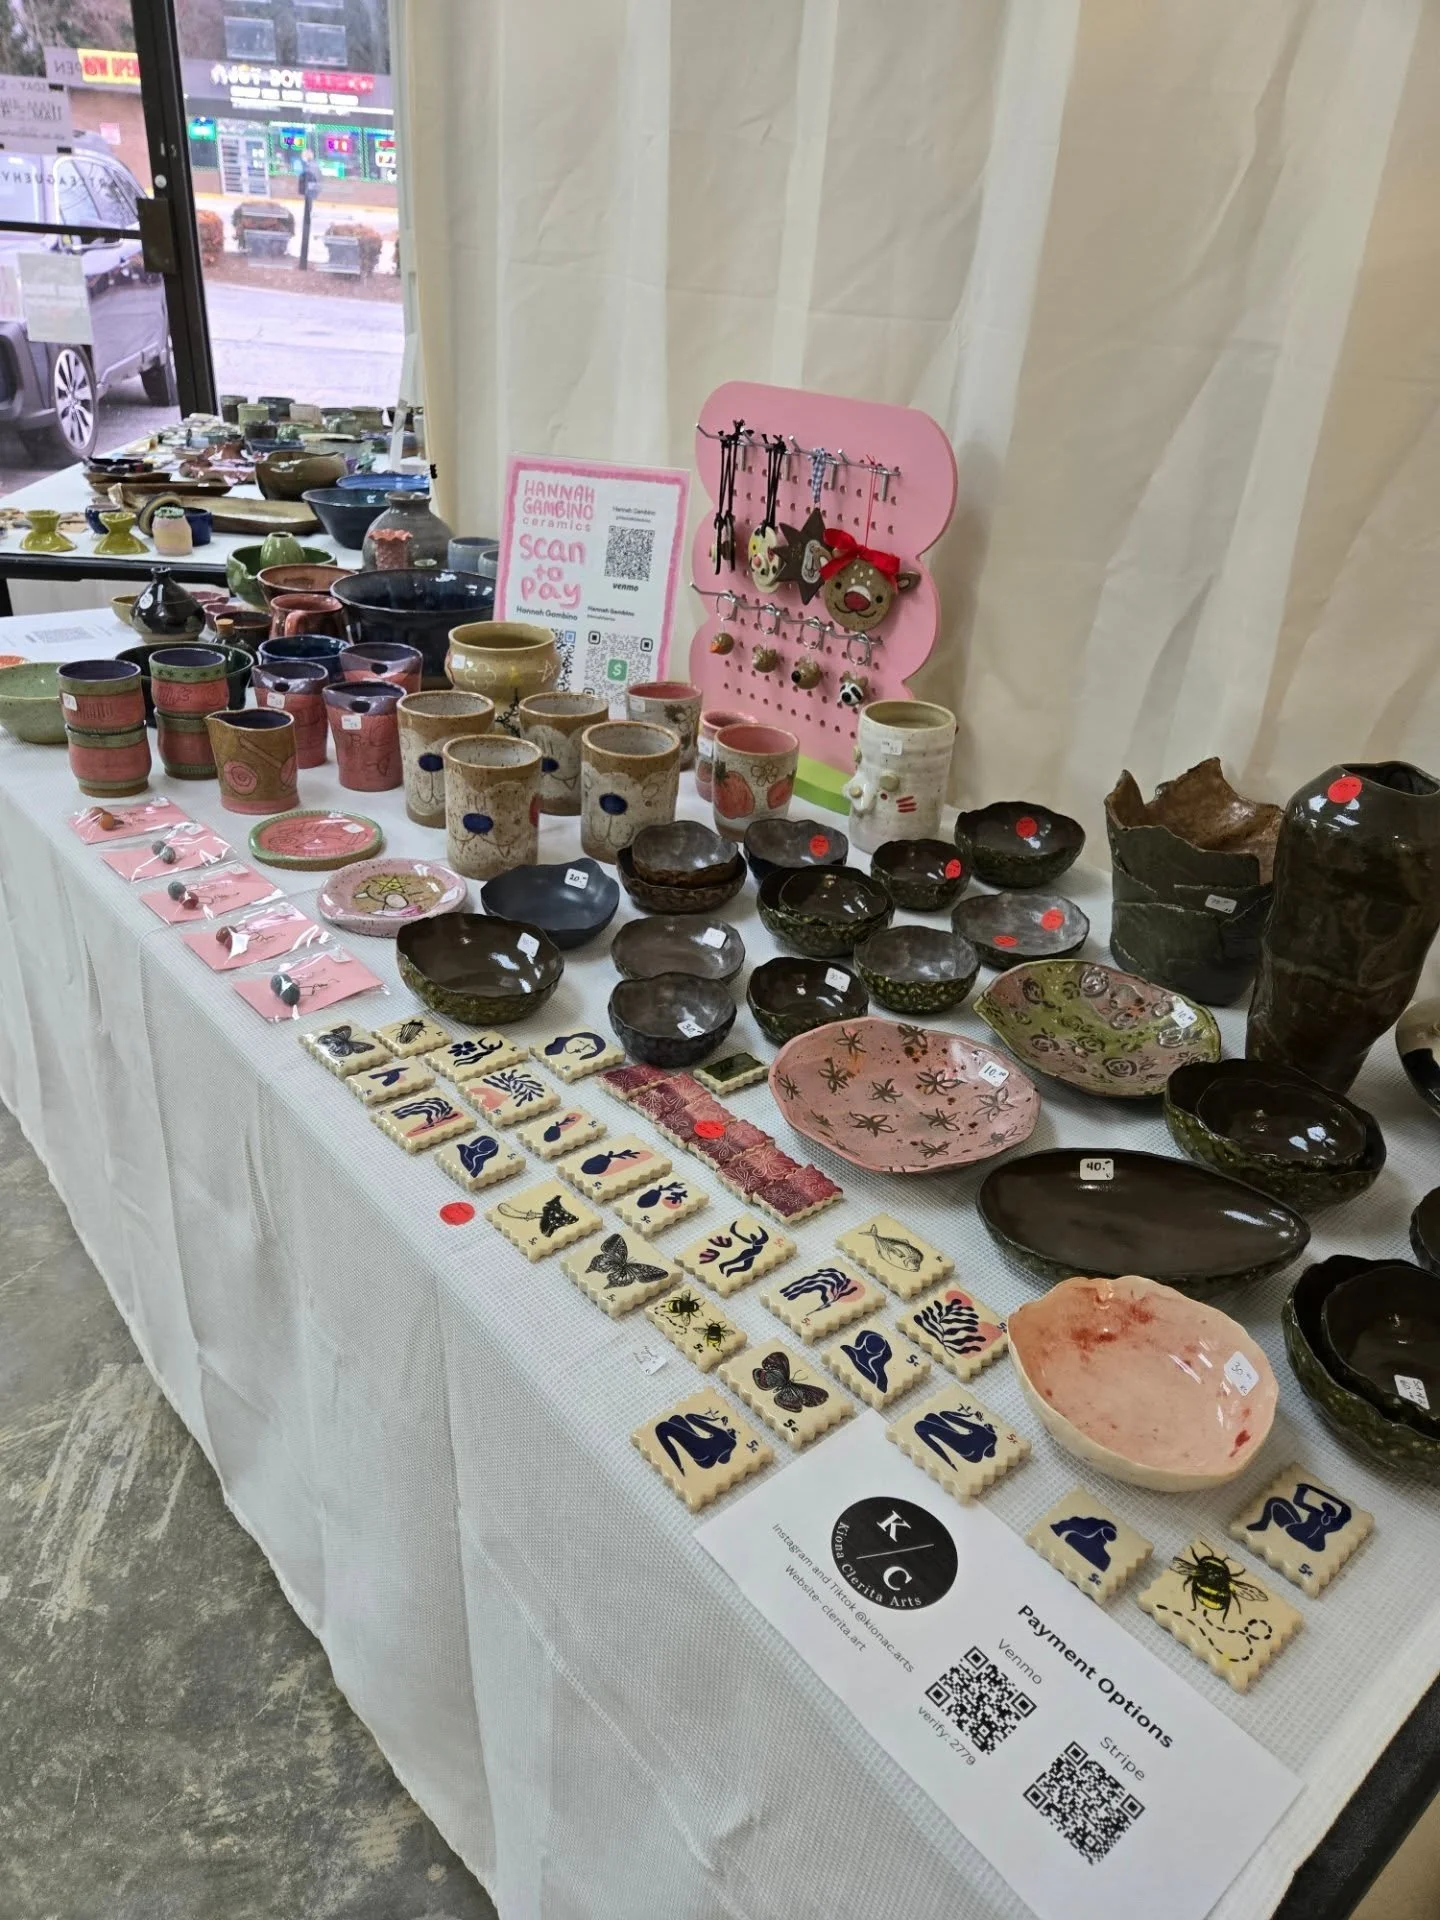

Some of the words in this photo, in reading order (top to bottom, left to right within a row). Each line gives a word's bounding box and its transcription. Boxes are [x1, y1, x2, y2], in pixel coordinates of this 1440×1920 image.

[524, 480, 595, 503] HANNAH
[522, 497, 594, 521] GAMBINO
[522, 516, 592, 532] ceramics
[613, 505, 632, 514] Hannah
[519, 533, 587, 566] scan
[535, 563, 564, 582] to
[612, 581, 639, 592] venmo
[520, 576, 582, 609] pay
[516, 605, 544, 618] Hannah
[545, 608, 578, 621] Gambino
[587, 605, 610, 615] Hannah
[610, 608, 635, 618] Gambino
[834, 1521, 851, 1560] Kiona
[876, 1510, 912, 1542] K
[841, 1562, 884, 1603] Clerita
[883, 1565, 912, 1592] C
[772, 1523, 814, 1569] Instagram
[811, 1564, 831, 1585] and
[829, 1581, 857, 1612] Tiktok
[854, 1609, 914, 1673] @kionac.arts
[889, 1595, 923, 1608] Arts
[821, 1602, 867, 1652] clerita.art
[998, 1637, 1044, 1686] Venmo
[1017, 1604, 1098, 1680] Payment
[1097, 1677, 1175, 1749] Options
[917, 1706, 949, 1741] verify:
[949, 1737, 977, 1767] 2779
[1099, 1736, 1147, 1782] Stripe
